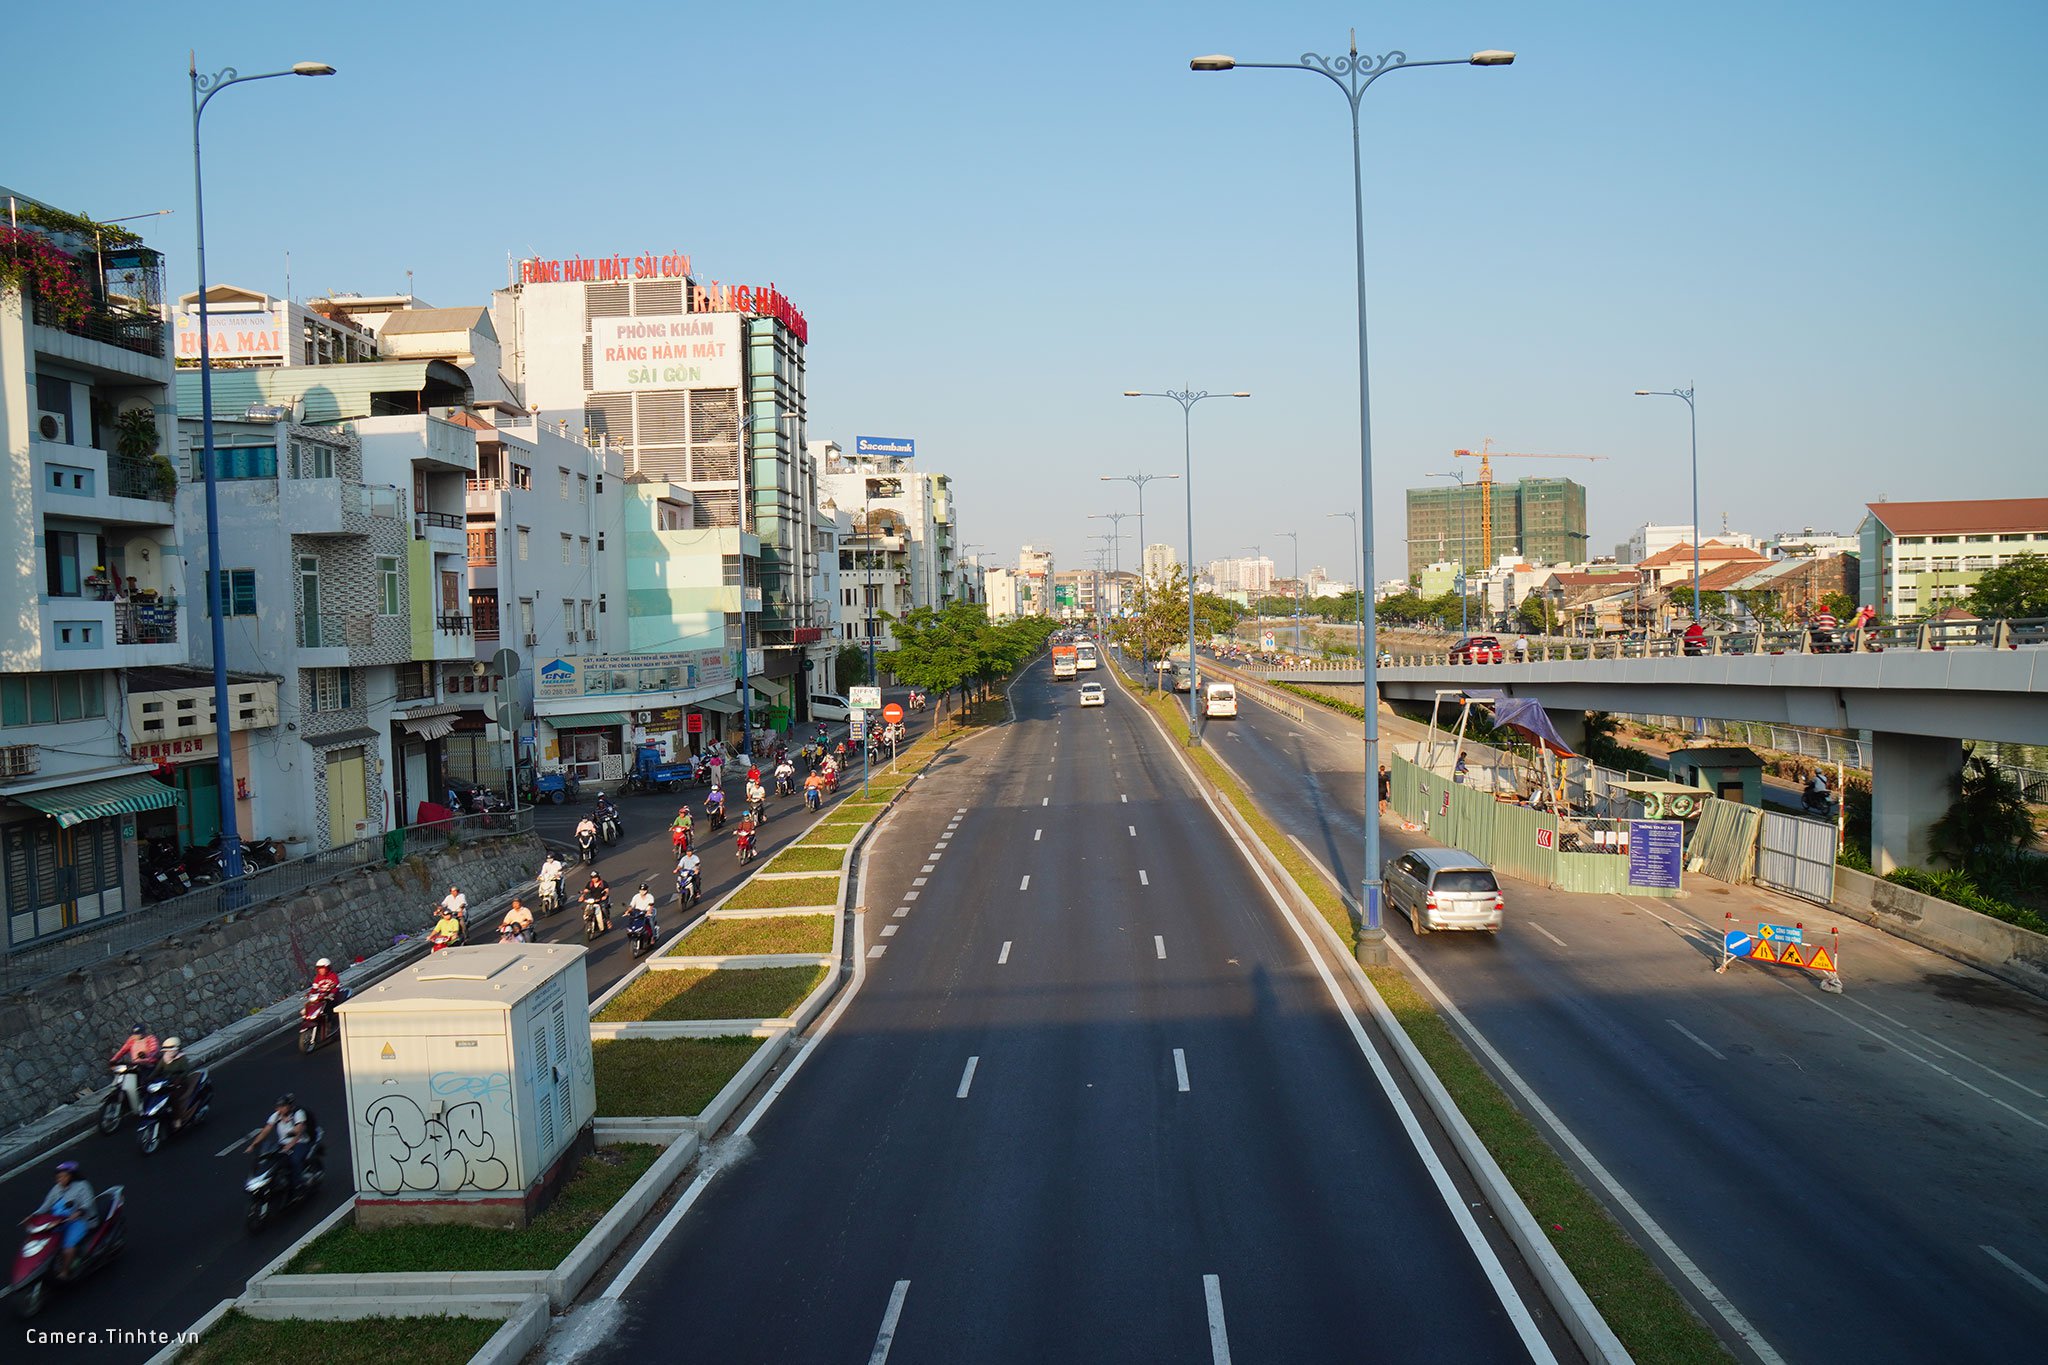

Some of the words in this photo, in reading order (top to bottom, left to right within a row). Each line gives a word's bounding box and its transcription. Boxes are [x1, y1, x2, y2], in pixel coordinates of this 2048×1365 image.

[523, 256, 559, 283] RĂNG
[564, 254, 595, 281] HÀM
[599, 253, 630, 285] MẶT
[634, 250, 658, 279] SÀI
[662, 249, 691, 277] GÒN
[693, 280, 751, 313] RĂNG
[617, 321, 666, 339] PHÒNG
[670, 319, 714, 337] KHÁM
[180, 331, 229, 353] HOA
[236, 330, 280, 352] MAI
[605, 344, 647, 361] RĂNG
[652, 341, 687, 359] HÀM
[693, 340, 726, 361] MẶT
[627, 365, 657, 384] SÀI
[663, 363, 701, 382] GÒN
[859, 439, 912, 453] Sacombank
[545, 672, 572, 680] CNC
[123, 826, 134, 837] 45
